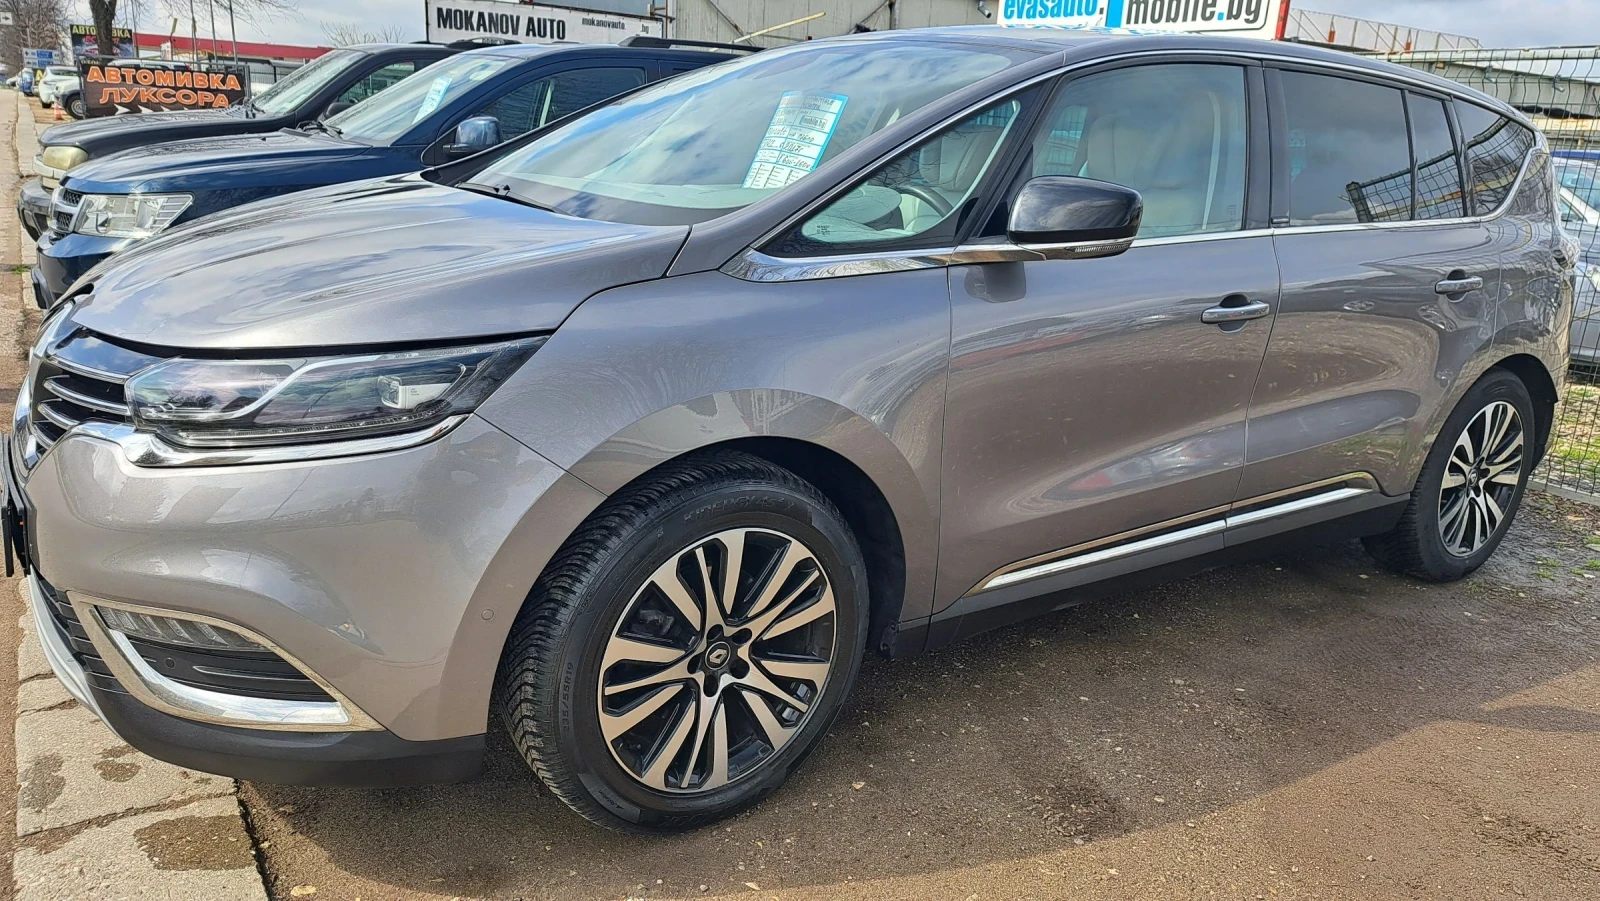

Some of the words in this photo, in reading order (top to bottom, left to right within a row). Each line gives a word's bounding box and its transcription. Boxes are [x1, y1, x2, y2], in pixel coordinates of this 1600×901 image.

[437, 7, 520, 36] MOKANOV
[525, 16, 566, 40] AUTO
[1126, 0, 1261, 25] mobile.bg
[72, 25, 131, 38] АВТОВКА
[86, 66, 241, 90] АВТОМИВКА
[99, 87, 229, 108] ЛУКСОРА
